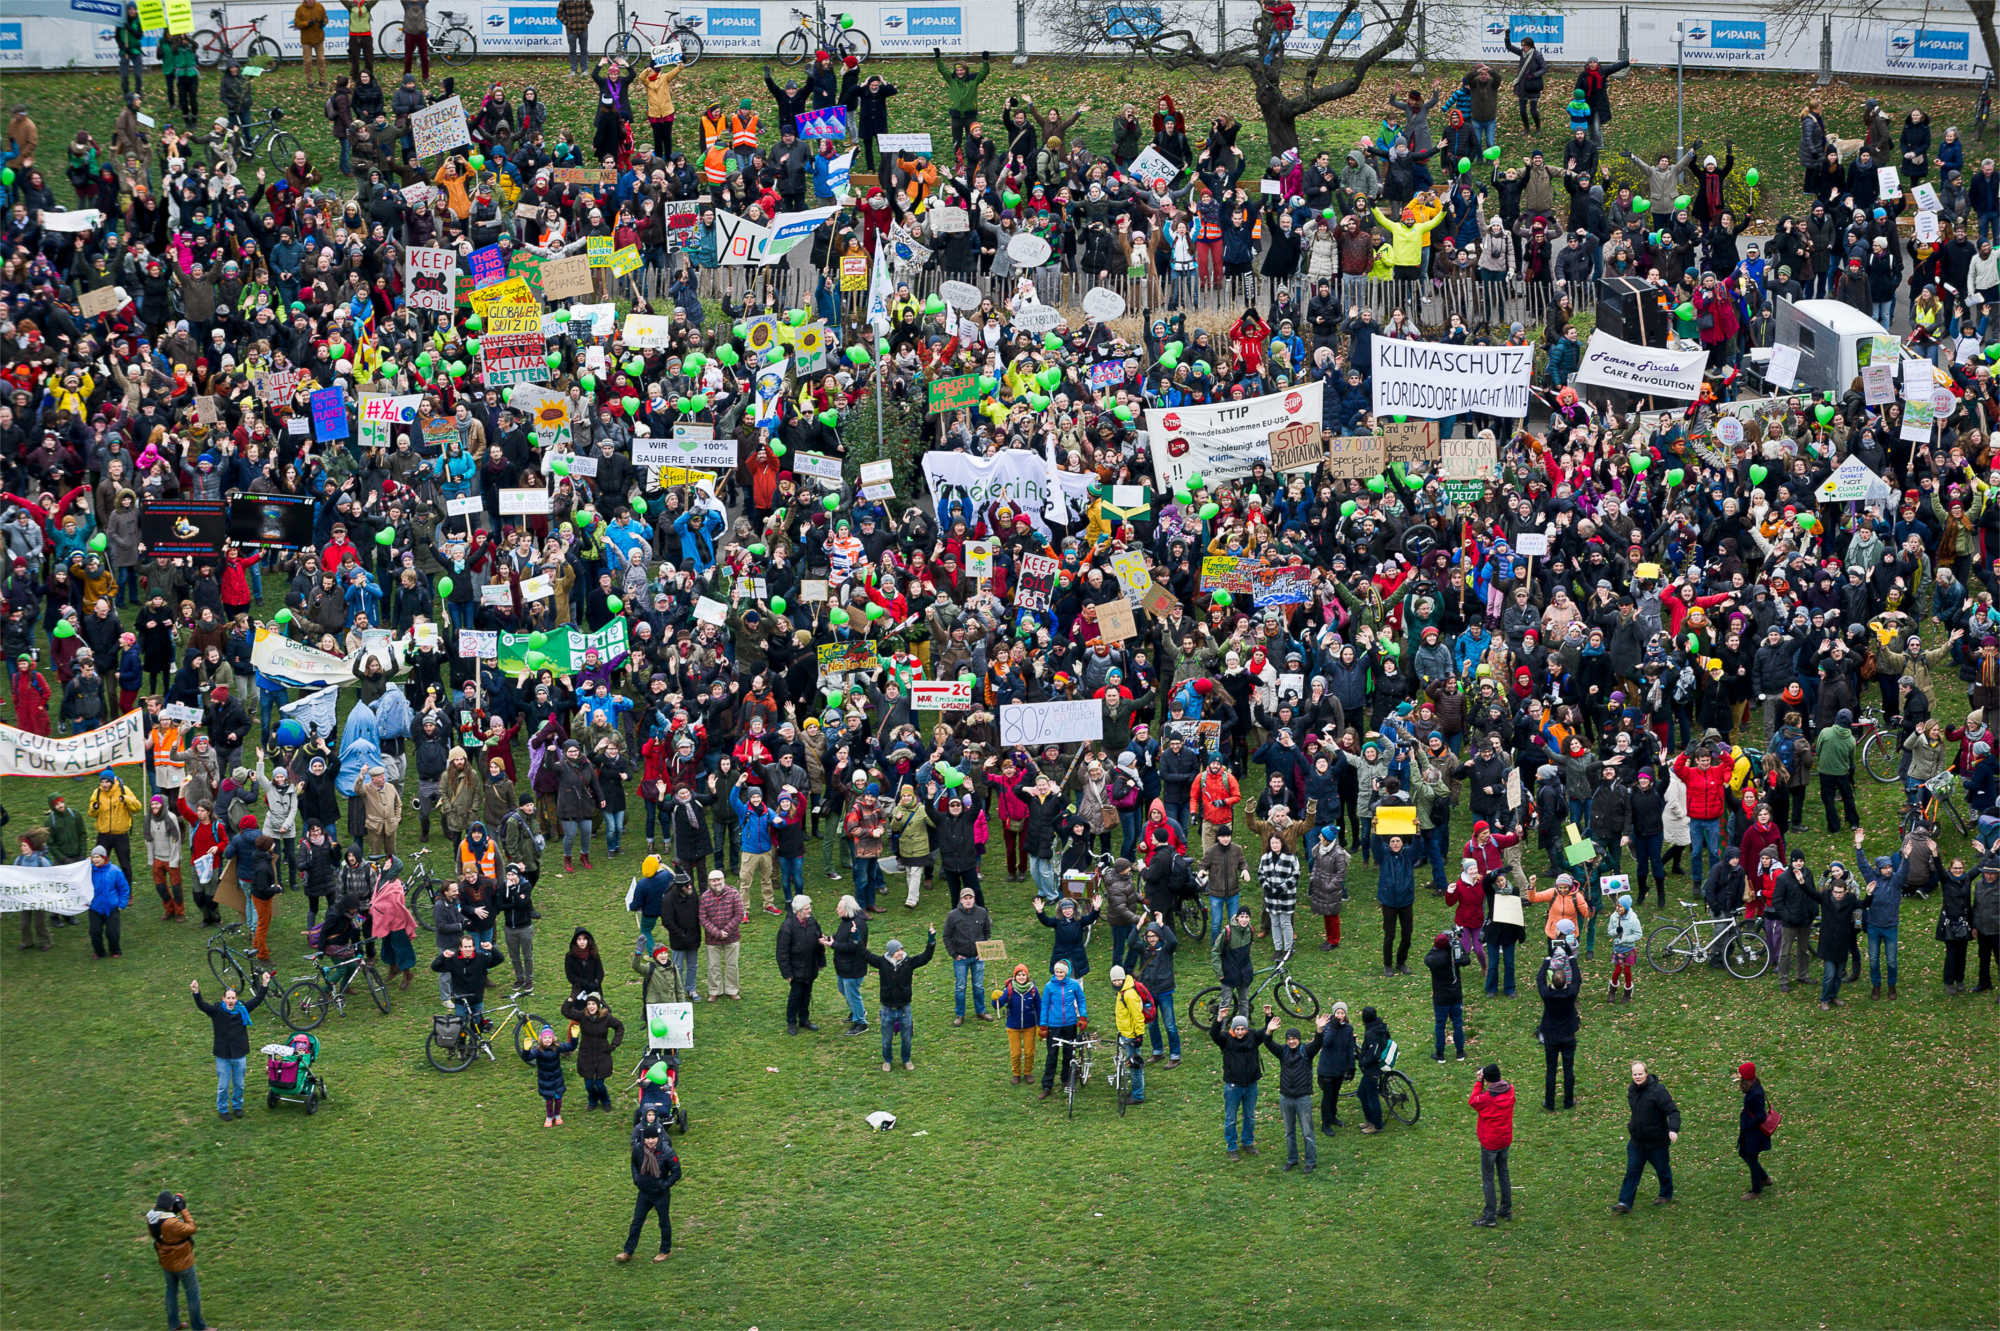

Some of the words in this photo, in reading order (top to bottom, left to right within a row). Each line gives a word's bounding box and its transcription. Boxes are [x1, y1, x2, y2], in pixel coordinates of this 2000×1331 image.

[483, 37, 562, 48] www.wipark.at
[881, 38, 961, 48] www.wipark.at
[1684, 50, 1765, 62] www.wipark.at
[1886, 60, 1968, 72] www.wipark.at
[805, 125, 843, 136] COOL
[1154, 158, 1175, 177] STOP
[411, 250, 453, 270] KEEP
[471, 248, 498, 264] THERE
[475, 263, 483, 272] IS
[486, 259, 501, 270] NO
[543, 258, 588, 279] SYSTEM
[417, 278, 443, 290] OIL
[548, 276, 585, 291] CHANGE
[410, 293, 450, 312] SOIL
[489, 305, 540, 318] GLOBALER
[493, 319, 537, 332] SUIZID
[482, 333, 545, 348] INVESTOREN
[486, 345, 542, 360] RAUS
[1380, 344, 1530, 375] KLIMASCHUTZ-
[484, 356, 547, 373] KLIMA
[1590, 352, 1636, 368] Femme
[1637, 360, 1680, 372] Fiscale
[490, 368, 550, 385] RETTEN
[1603, 366, 1628, 379] CARE
[933, 377, 975, 395] HANDELN
[1381, 381, 1457, 410] FLORIDSDORF
[1461, 387, 1502, 408] MACHT
[1504, 384, 1528, 409] MIT!
[314, 407, 343, 422] PLANET
[1217, 406, 1249, 422] TTIP
[326, 419, 335, 432] B
[1386, 424, 1398, 434] and
[1404, 424, 1416, 434] only
[538, 431, 553, 440] help
[1276, 424, 1314, 451] STOP
[1401, 434, 1408, 442] is
[1386, 442, 1425, 453] destroying
[1442, 440, 1473, 457] FOCUS
[1477, 440, 1491, 455] ON
[1333, 455, 1364, 466] species
[1365, 454, 1379, 464] live
[670, 469, 686, 480] fossil
[690, 470, 705, 479] free
[1334, 469, 1344, 477] on
[1352, 465, 1377, 478] Earth
[1840, 465, 1867, 473] SYSTEM
[1024, 554, 1055, 574] KEEP
[1023, 576, 1049, 593] OIL
[1004, 704, 1052, 744] 80%
[84, 716, 138, 749] LEBEN
